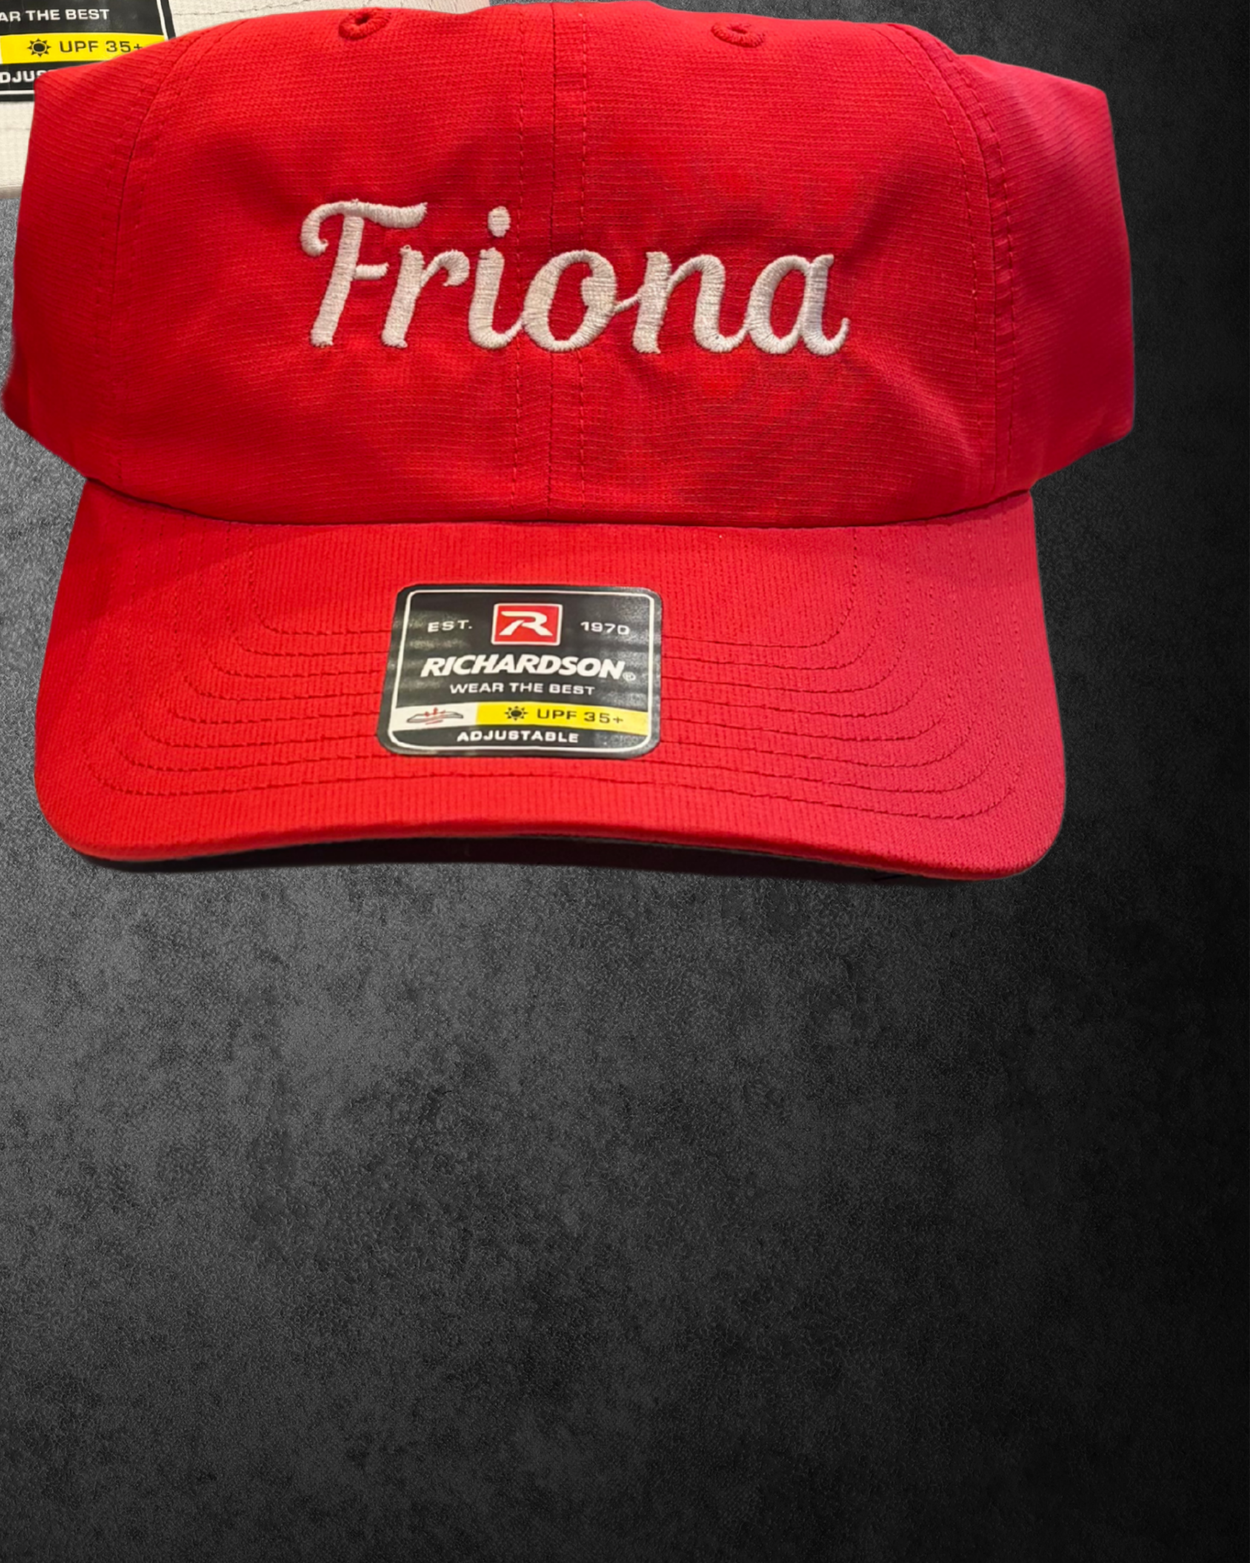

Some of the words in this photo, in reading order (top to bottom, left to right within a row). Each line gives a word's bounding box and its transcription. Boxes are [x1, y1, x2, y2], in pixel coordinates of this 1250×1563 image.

[25, 9, 61, 22] THE
[65, 8, 110, 21] BEST
[59, 40, 99, 54] UPF
[300, 199, 849, 355] Friona
[427, 620, 473, 633] EST.
[580, 621, 630, 635] 1970
[450, 683, 504, 695] WEAR
[509, 682, 543, 694] THE
[549, 684, 595, 696] BEST
[537, 708, 577, 720] UPF
[584, 711, 624, 725] 35+
[456, 730, 579, 744] ADJUSTABLE
